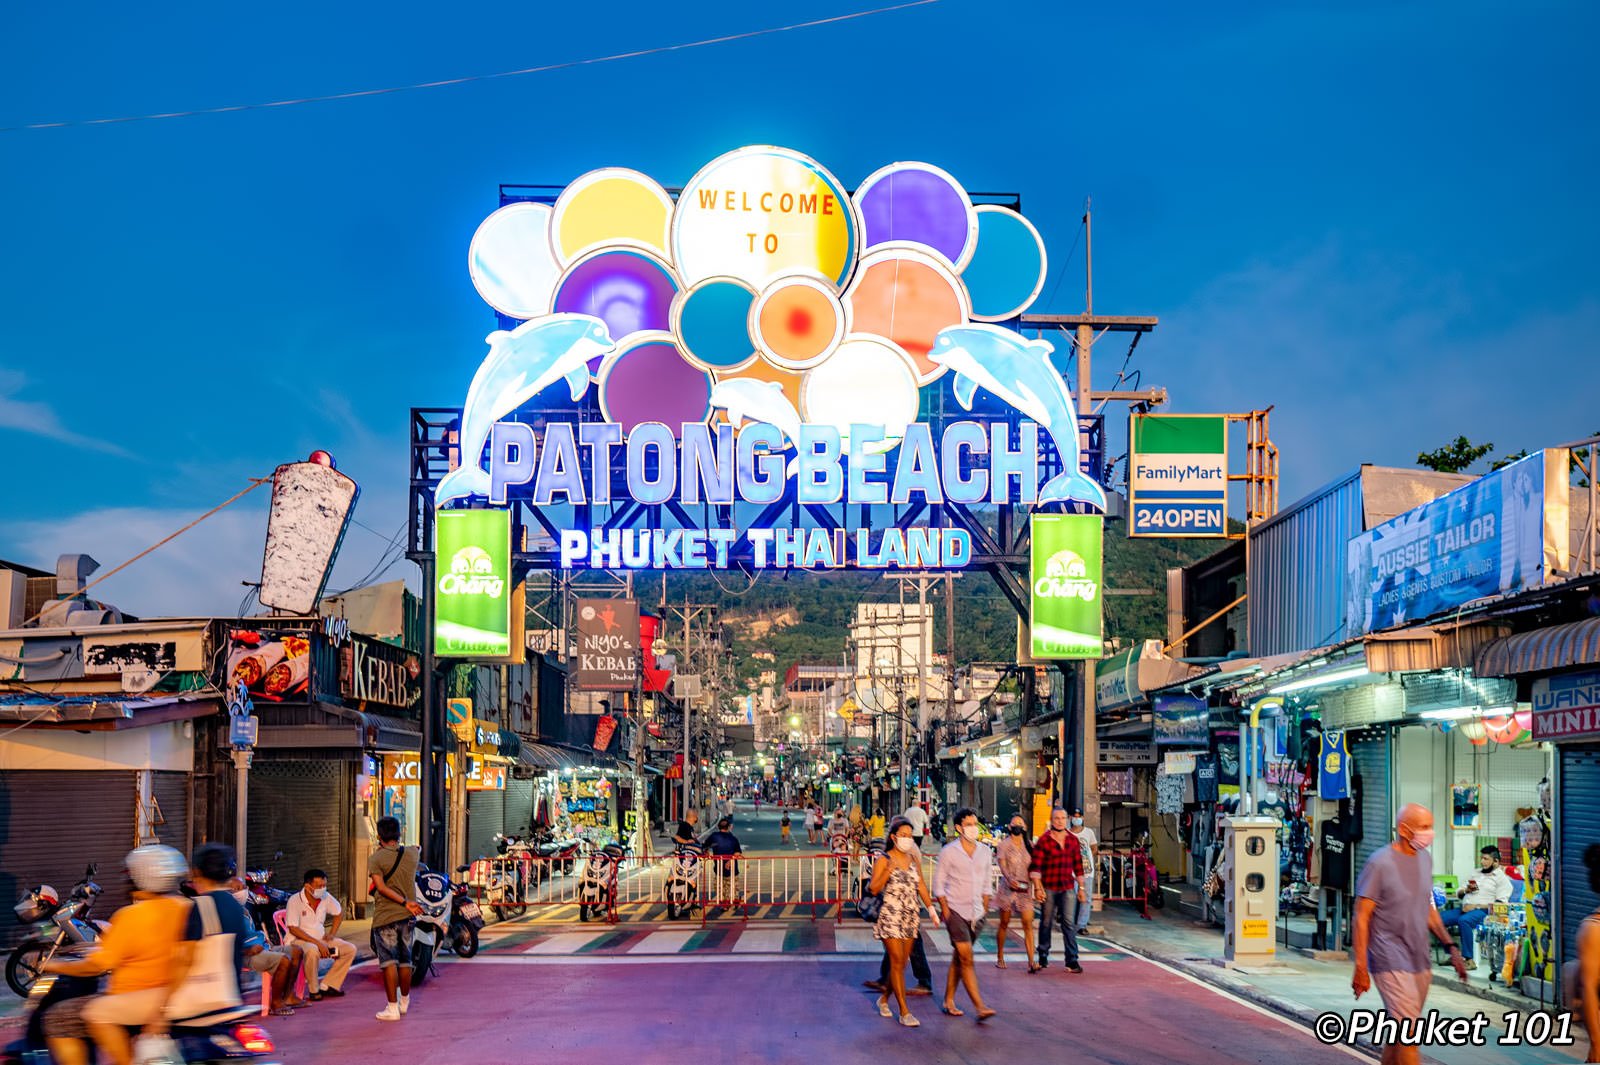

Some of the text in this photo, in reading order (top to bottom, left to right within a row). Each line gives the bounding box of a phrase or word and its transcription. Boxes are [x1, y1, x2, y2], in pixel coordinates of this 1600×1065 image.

[699, 189, 834, 215] WELCOME
[746, 233, 778, 254] TO
[489, 421, 1039, 505] PATONG BEACH
[1136, 465, 1222, 483] FamilyMart
[1137, 509, 1221, 528] 24OPEN
[560, 528, 736, 569] PHUKET
[1376, 513, 1496, 579] AUSSIE TAILOR
[438, 573, 504, 598] Chang
[1034, 576, 1097, 602] Chang
[353, 639, 407, 708] KEBAB
[581, 653, 636, 671] KEBAB
[1537, 706, 1600, 735] MINI
